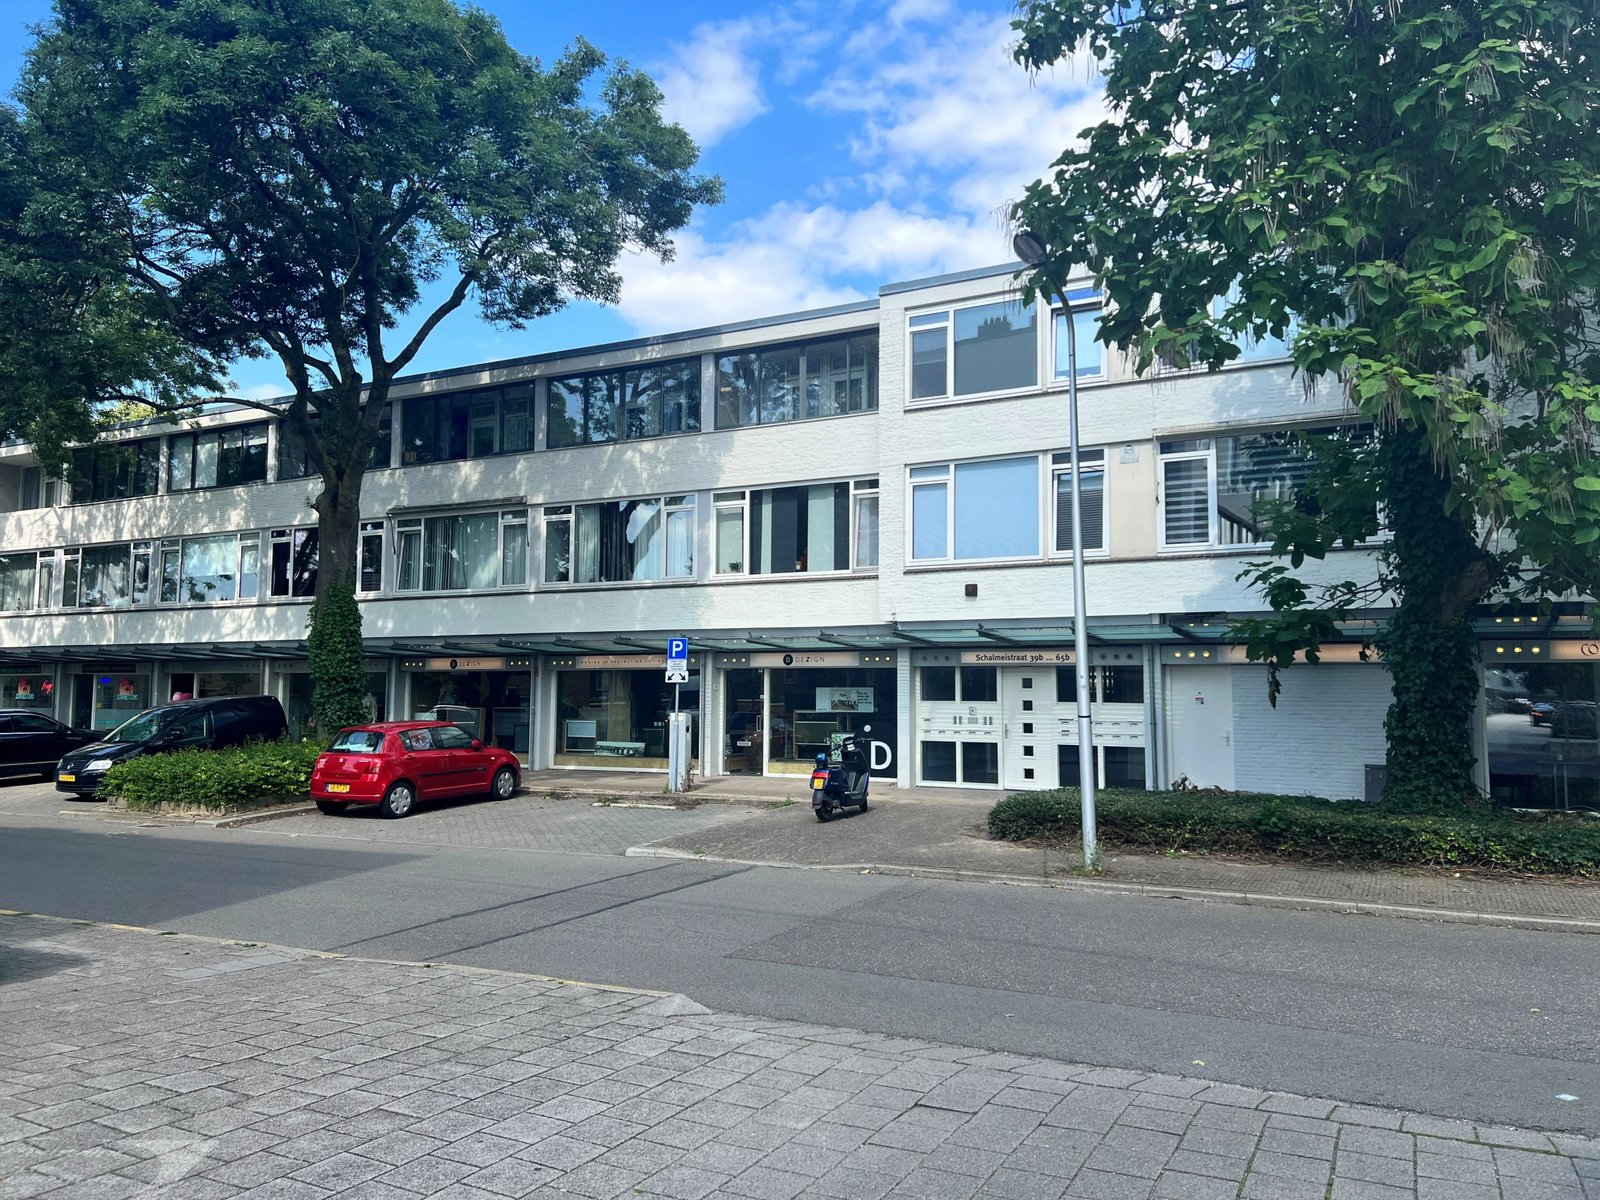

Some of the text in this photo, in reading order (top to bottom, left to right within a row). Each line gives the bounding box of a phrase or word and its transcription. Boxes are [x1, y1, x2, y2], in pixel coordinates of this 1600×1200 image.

[672, 641, 684, 657] P
[975, 653, 1028, 662] Schalmeistraat
[1029, 654, 1044, 662] 39b
[1055, 653, 1070, 662] 65b
[870, 740, 892, 770] D
